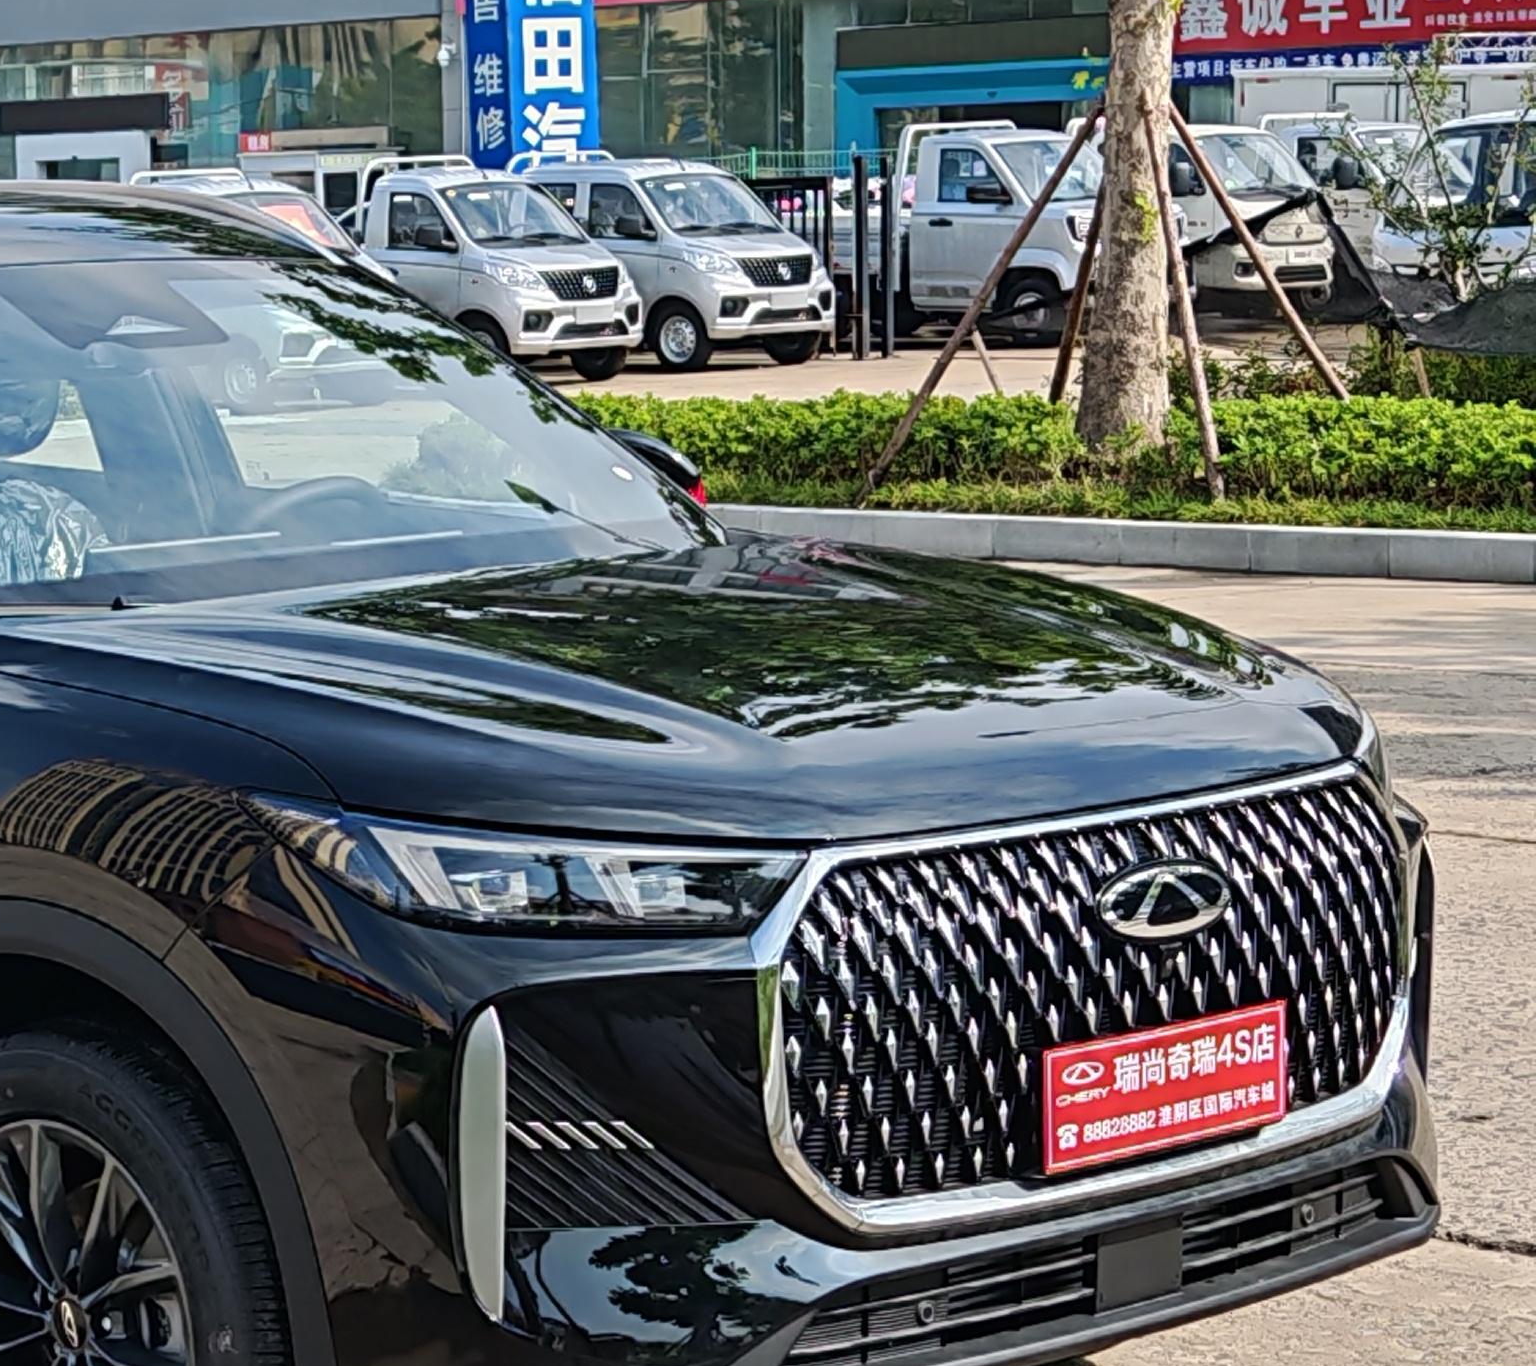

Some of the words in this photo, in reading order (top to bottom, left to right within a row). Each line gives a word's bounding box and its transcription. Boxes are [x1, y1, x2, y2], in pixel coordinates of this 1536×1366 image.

[473, 52, 506, 151] 维修
[1113, 1024, 1277, 1094] 瑞尚奇瑞4S店
[1056, 1086, 1112, 1108] CHERY
